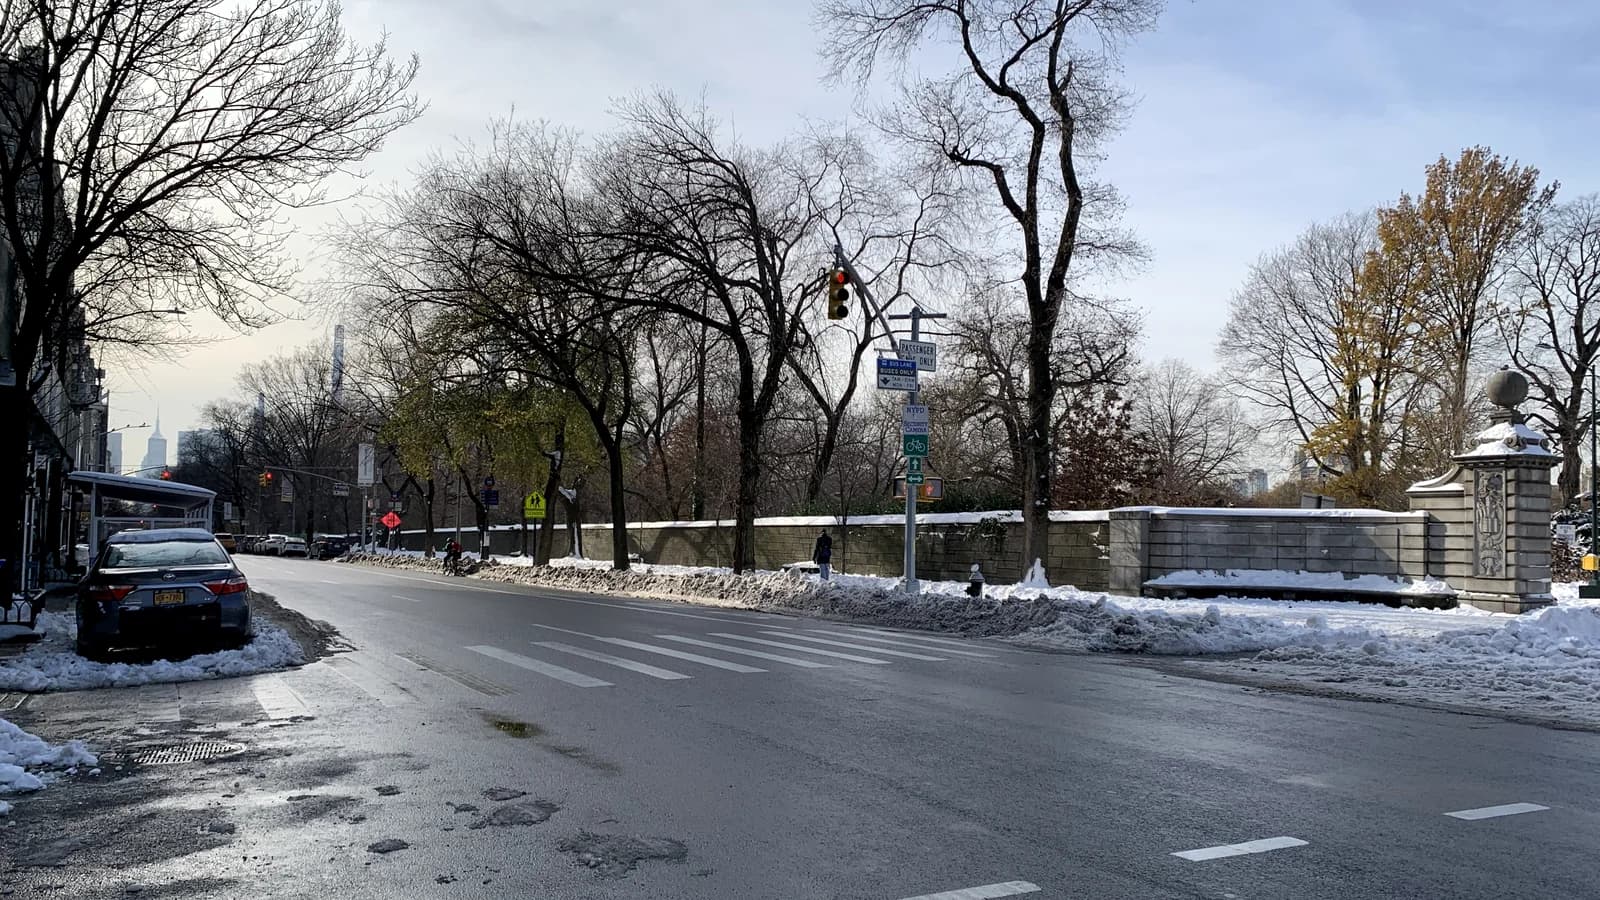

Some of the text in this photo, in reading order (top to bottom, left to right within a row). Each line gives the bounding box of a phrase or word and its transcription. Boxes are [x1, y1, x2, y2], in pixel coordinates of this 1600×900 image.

[901, 343, 933, 355] PASSENGER
[919, 357, 933, 367] ONLY
[880, 367, 898, 375] BUSES
